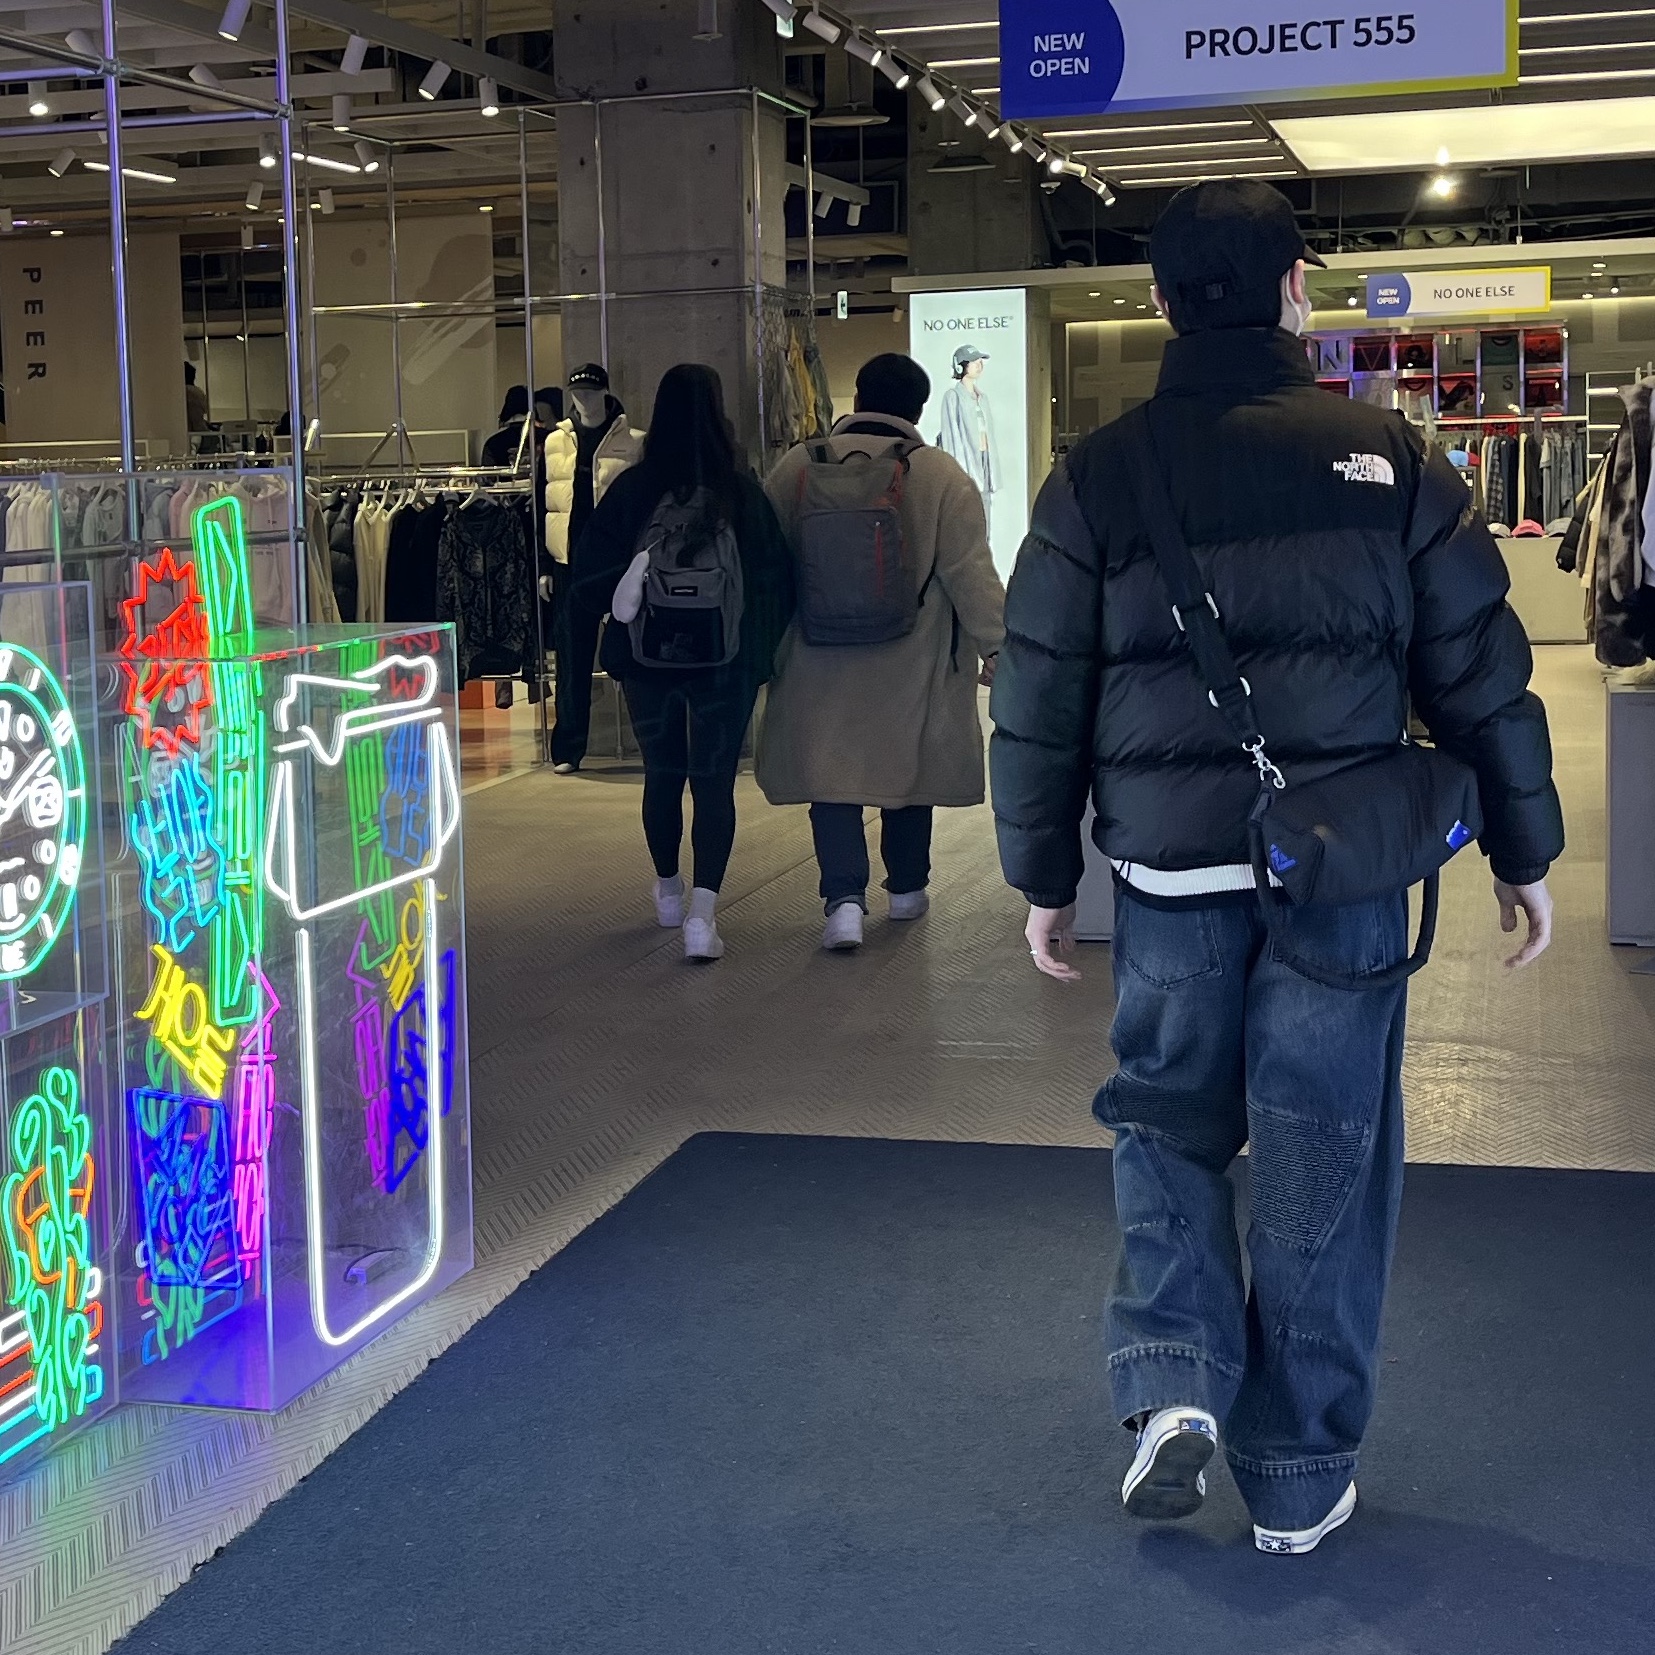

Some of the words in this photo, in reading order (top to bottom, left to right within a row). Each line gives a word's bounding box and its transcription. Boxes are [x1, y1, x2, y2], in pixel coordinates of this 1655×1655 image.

[1033, 32, 1085, 54] NEW
[1185, 19, 1345, 59] PROJECT
[1353, 14, 1416, 47] 555
[1029, 57, 1090, 78] OPEN
[1378, 288, 1398, 296] NEW
[1433, 288, 1453, 299] NO
[1455, 287, 1482, 299] ONE
[1485, 285, 1516, 297] ELSE
[22, 267, 47, 380] PEER
[923, 320, 944, 331] NO
[947, 318, 975, 330] ONE
[1349, 453, 1374, 463] THE
[1333, 461, 1375, 472] NORTH
[1345, 470, 1375, 481] FACE
